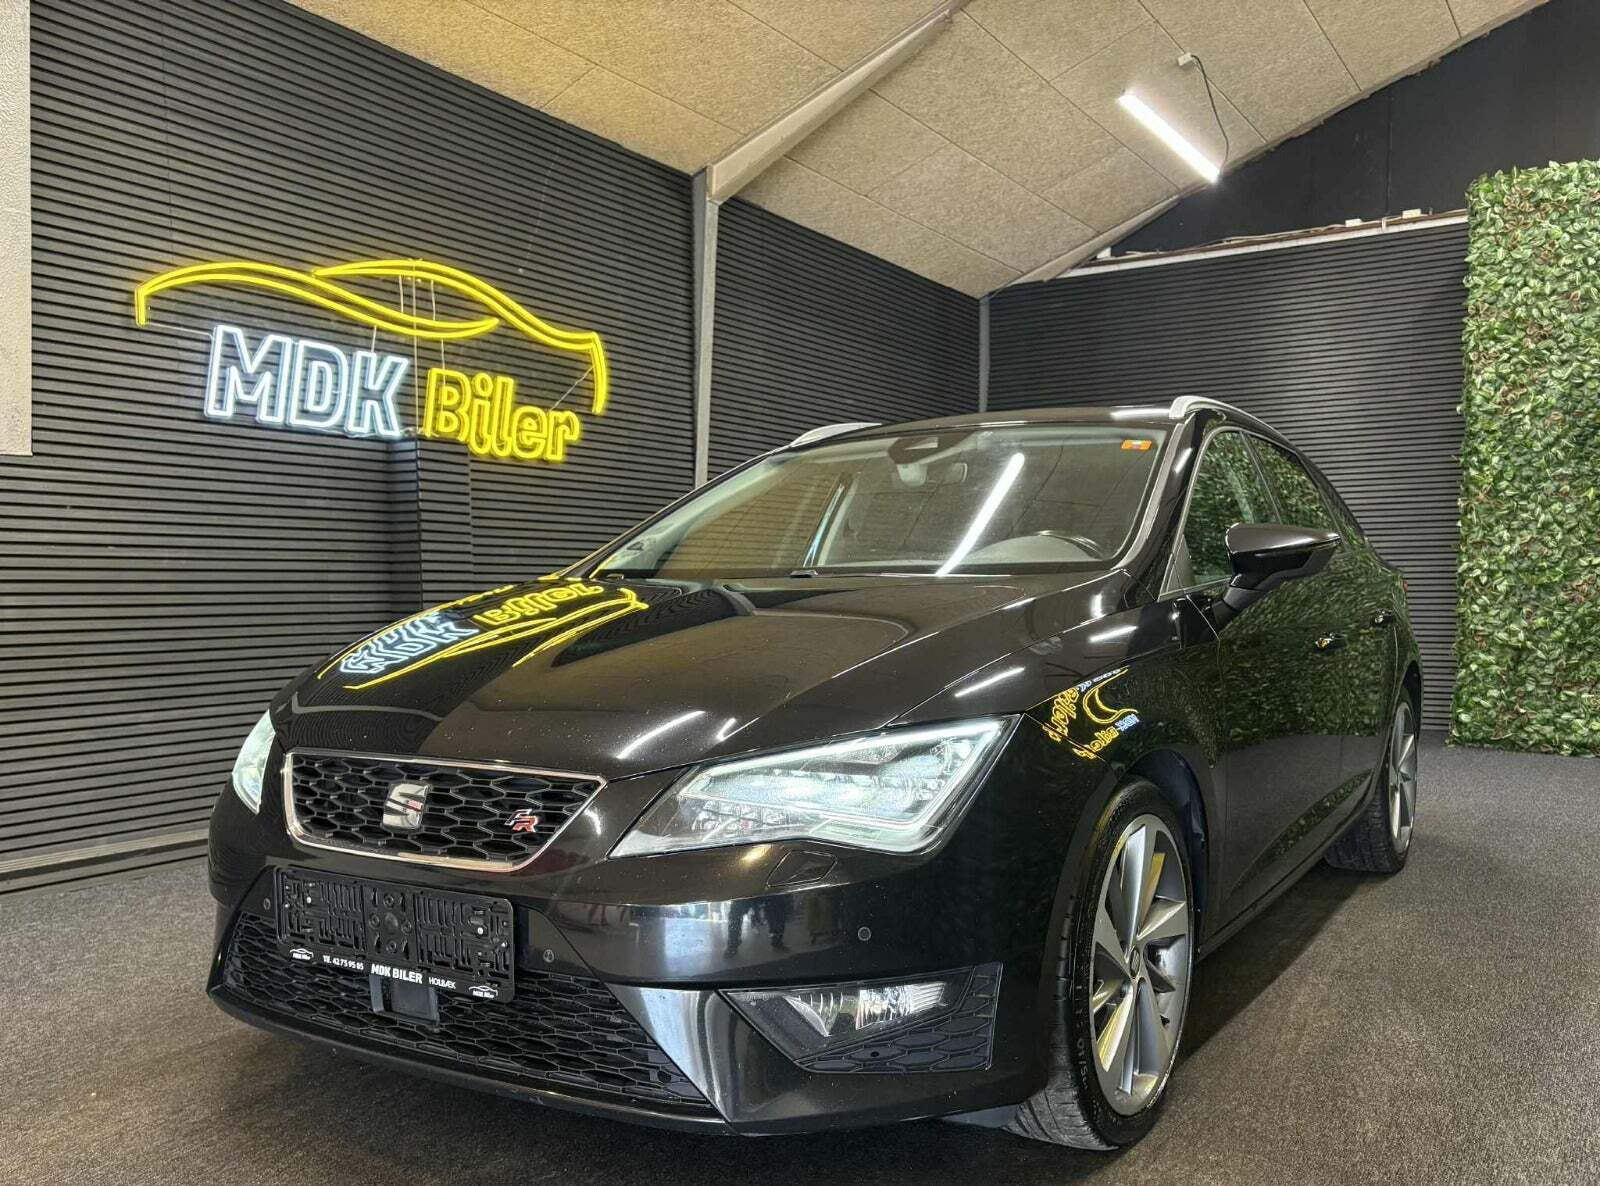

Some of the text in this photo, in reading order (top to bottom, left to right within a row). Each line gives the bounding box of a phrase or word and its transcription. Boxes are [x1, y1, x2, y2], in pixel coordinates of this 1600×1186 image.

[203, 324, 581, 462] MDK Biler
[370, 962, 392, 978] MDK
[391, 967, 423, 985] BILER
